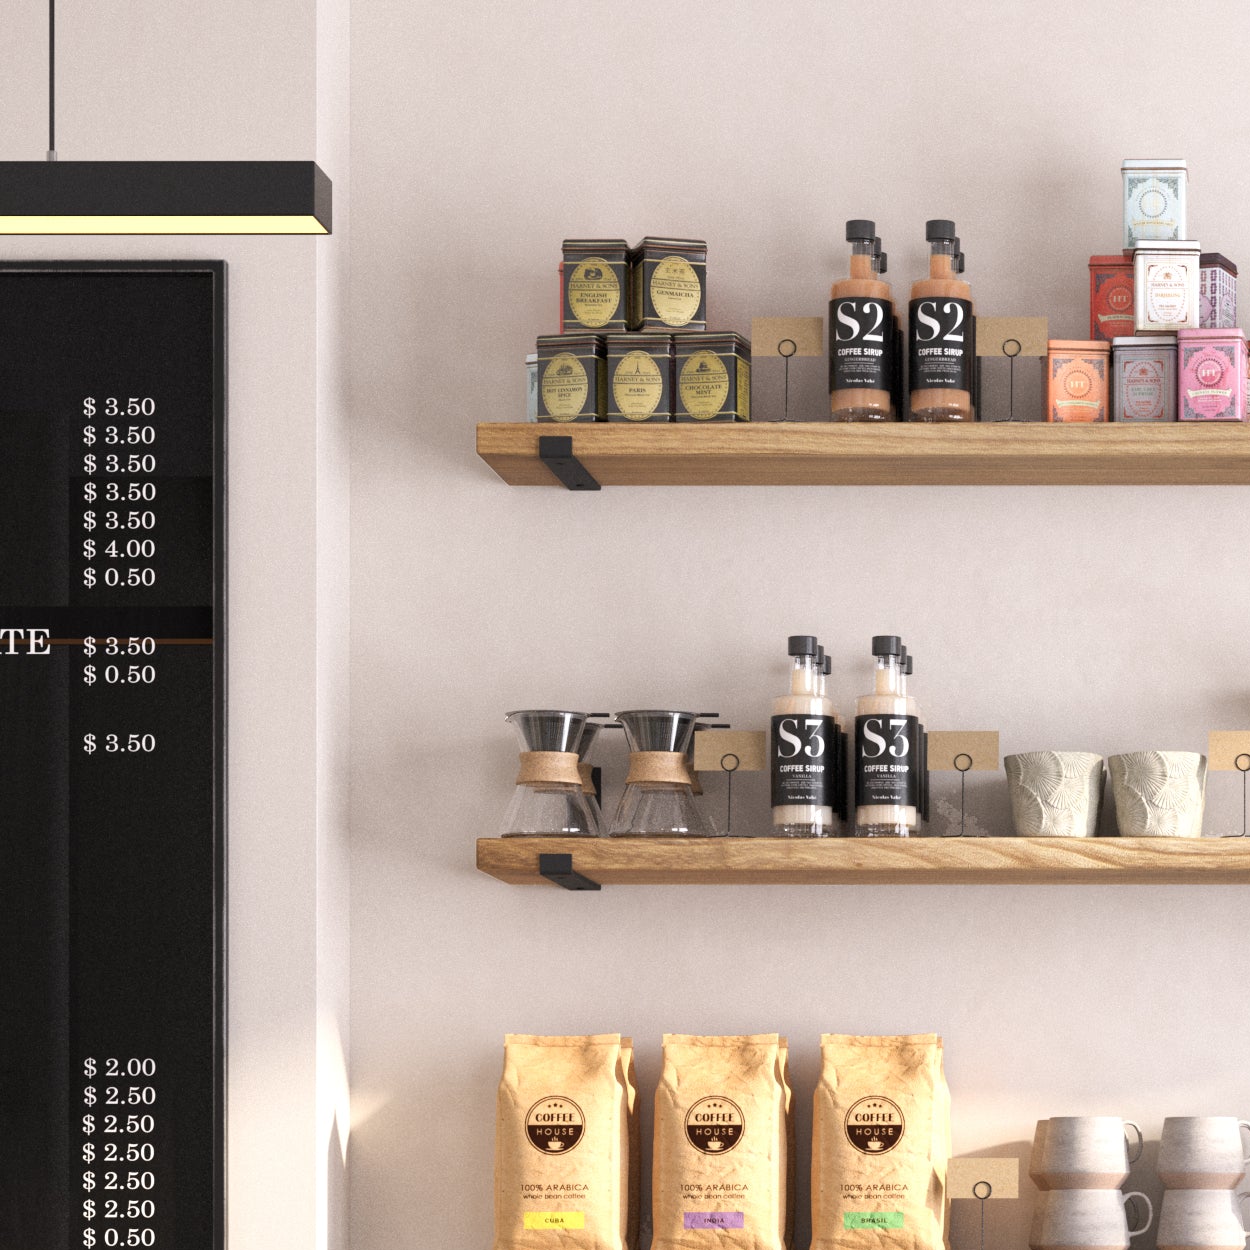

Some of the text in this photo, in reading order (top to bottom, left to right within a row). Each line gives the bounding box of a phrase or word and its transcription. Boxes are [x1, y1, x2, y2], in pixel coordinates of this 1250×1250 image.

[836, 301, 884, 342] S2
[916, 301, 964, 342] S2
[838, 347, 883, 356] COFFEE SIRUP
[918, 347, 963, 356] COFFEE SIRUP
[104, 397, 156, 416] 3.50
[104, 425, 156, 444] 3.50
[104, 454, 156, 473] 3.50
[104, 482, 156, 501] 3.50
[104, 511, 156, 530] 3.50
[104, 539, 156, 558] 4.00
[104, 567, 156, 586] 0.50
[0, 628, 51, 655] TE
[104, 636, 156, 655] 3.50
[104, 665, 156, 684] 0.50
[104, 734, 156, 753] 3.50
[778, 718, 825, 758] S3
[862, 718, 909, 758] S3
[780, 764, 825, 773] COFFEE SIRUP
[864, 764, 909, 773] COFFEE SIRUP
[105, 1058, 156, 1077] 2.00
[105, 1086, 156, 1105] 2.50
[103, 1114, 155, 1133] 2.50
[536, 1113, 575, 1122] COFFEE
[695, 1113, 734, 1122] COFFEE
[855, 1113, 894, 1122] COFFEE
[103, 1142, 155, 1162] 2.50
[103, 1171, 155, 1190] 2.50
[103, 1199, 156, 1219] 2.50
[103, 1227, 156, 1247] 0.50
